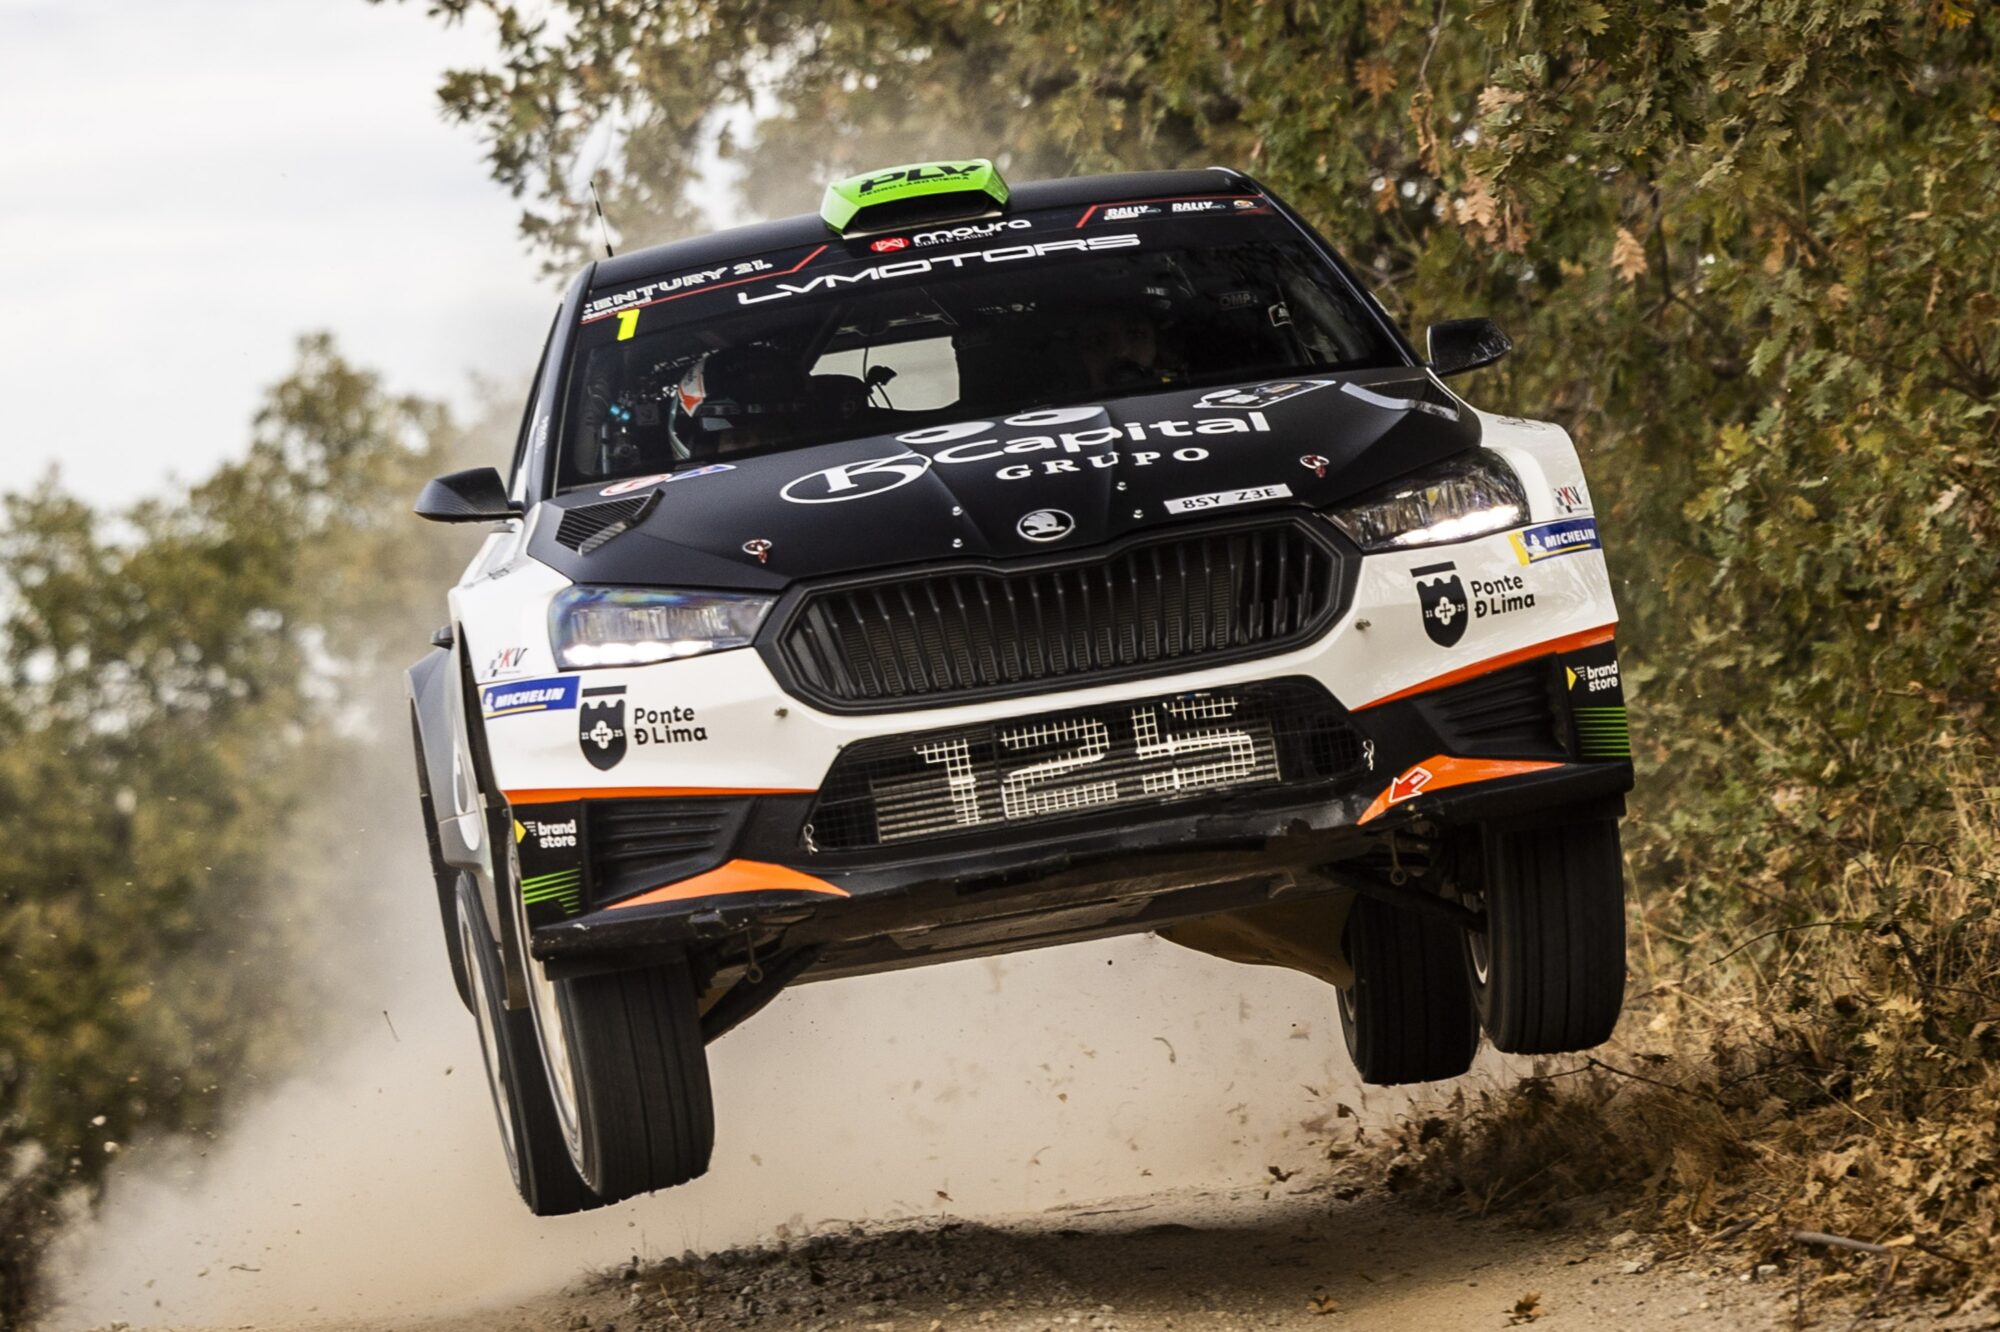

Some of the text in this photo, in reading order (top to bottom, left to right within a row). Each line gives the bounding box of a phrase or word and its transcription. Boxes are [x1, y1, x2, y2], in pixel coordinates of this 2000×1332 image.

[859, 165, 984, 193] PLV
[1107, 205, 1149, 218] RALLY
[1171, 201, 1213, 212] RALLY
[913, 219, 1032, 244] moura
[915, 231, 994, 248] CORTE LASER
[617, 308, 640, 341] 1
[933, 411, 1271, 464] Capital
[995, 446, 1210, 481] GRUPO
[1182, 488, 1278, 509] 8SY Z3E
[1544, 528, 1596, 548] MICHELIN
[1470, 575, 1523, 598] Ponte
[1491, 594, 1535, 615] Lima
[1587, 660, 1618, 680] brand
[1589, 676, 1618, 692] store
[494, 687, 566, 709] MICHELIN
[634, 706, 695, 725] Ponte
[652, 725, 708, 744] Lima
[537, 819, 577, 836] brand
[540, 835, 577, 848] store
